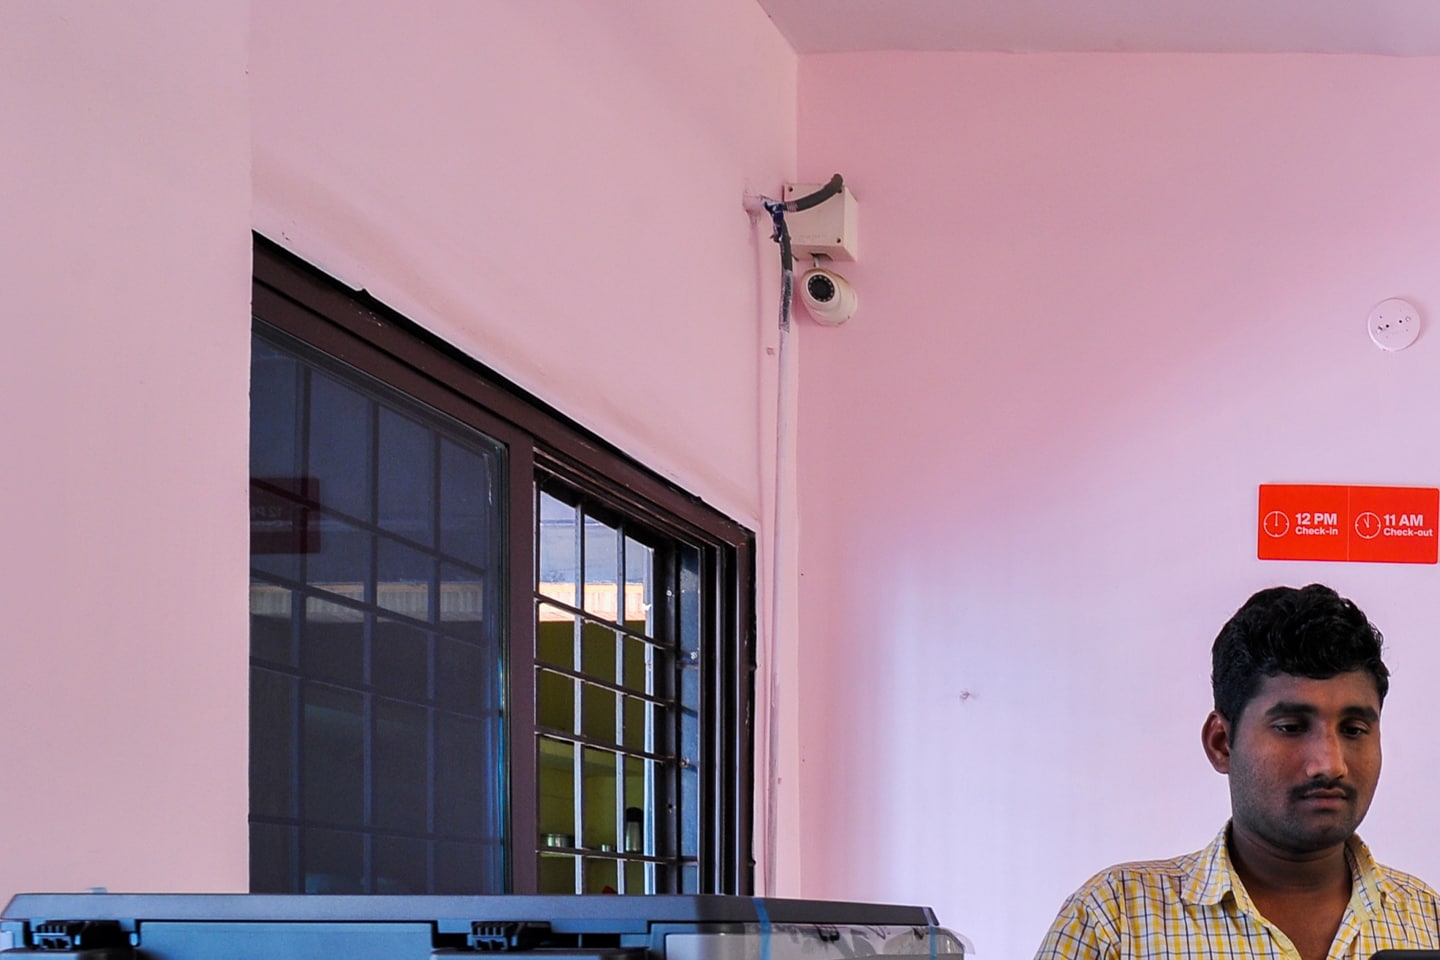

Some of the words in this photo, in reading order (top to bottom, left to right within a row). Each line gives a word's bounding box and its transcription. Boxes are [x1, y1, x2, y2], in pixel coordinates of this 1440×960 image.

[1295, 512, 1312, 525] 12
[1313, 512, 1338, 526] PM
[1383, 514, 1396, 526] 11
[1398, 514, 1424, 527] AM
[1295, 526, 1339, 535] Check-in
[1383, 527, 1433, 537] Check-out
